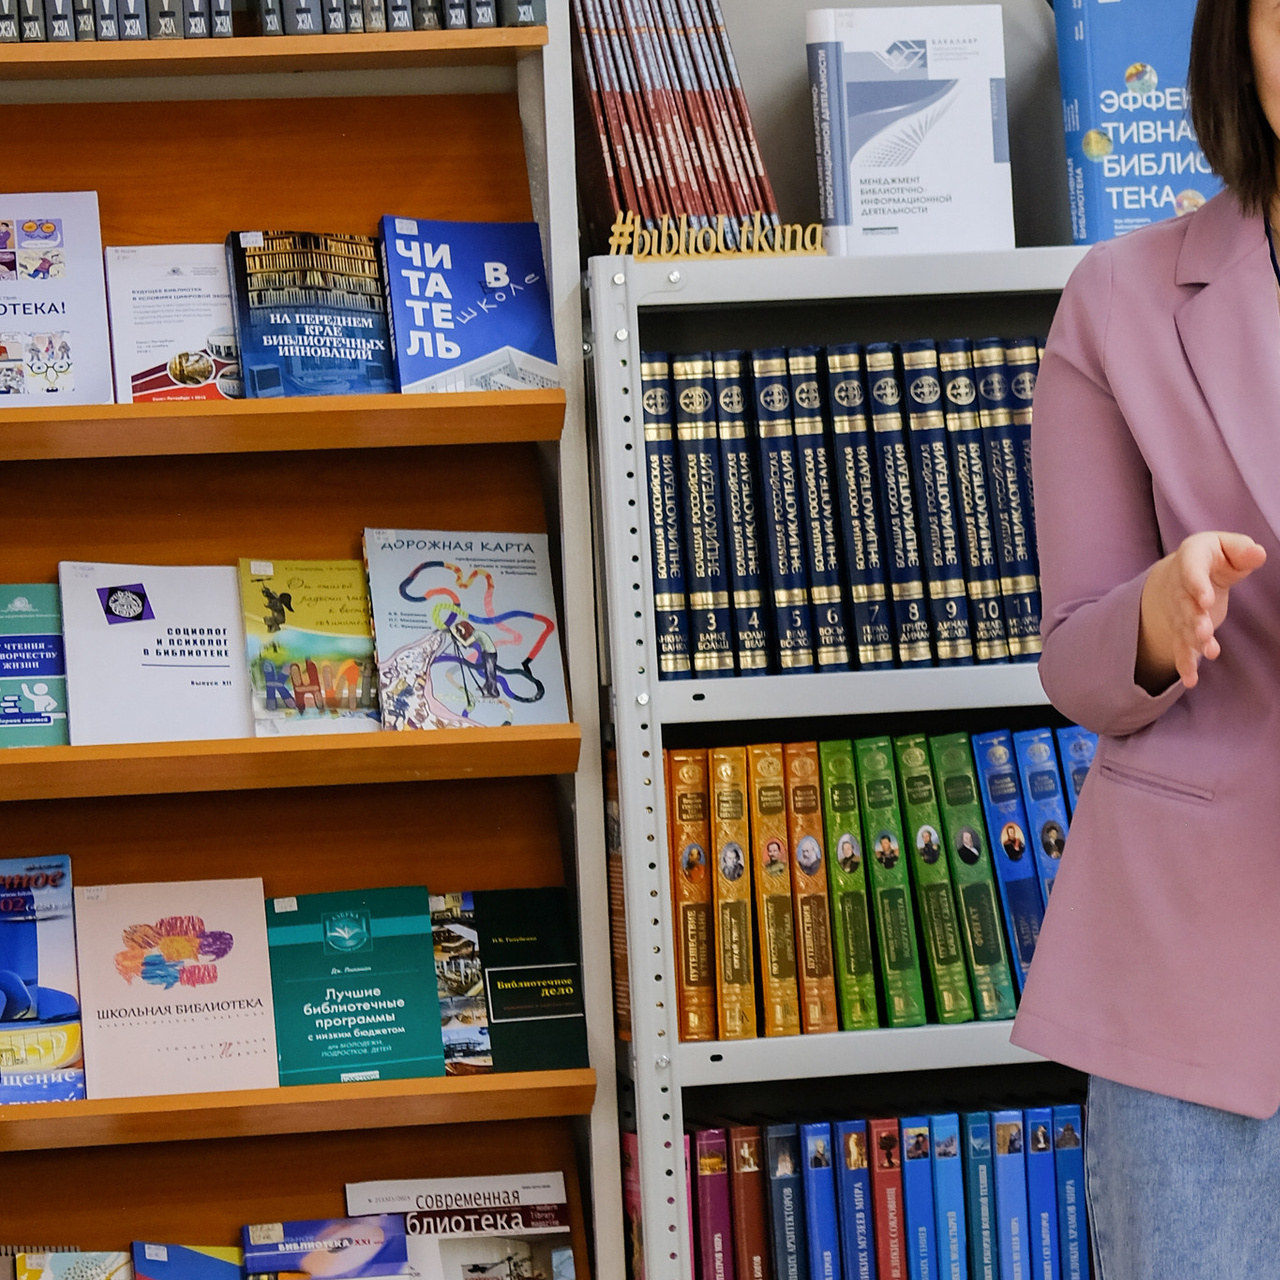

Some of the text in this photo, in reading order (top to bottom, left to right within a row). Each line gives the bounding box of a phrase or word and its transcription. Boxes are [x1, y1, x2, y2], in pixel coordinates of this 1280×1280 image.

[1101, 120, 1197, 144] ТИВНА
[860, 177, 920, 185] МЕНЕДЖМЕНТ
[861, 195, 953, 205] ИНФОРМАЦИОННОЙ
[1105, 185, 1177, 210] ТЕКА
[861, 207, 928, 216] ДЕЯТЕЛЬНОСТИ
[395, 239, 452, 270] ЧИ
[484, 261, 511, 288] В
[401, 269, 453, 300] ТА
[269, 313, 373, 329] НА ПЕРЕДНЕМ
[405, 299, 455, 329] ТЕ
[304, 324, 343, 337] КРАЕ
[262, 334, 386, 351] БИБЛИОТЕЧНЫХ
[406, 330, 462, 359] ЛЬ
[278, 346, 373, 361] ИННОВАЦИЙ
[650, 454, 667, 579] БОЛЬШАЯ РОССИЙСКАЯ
[663, 455, 681, 578] ЭНЦИКЛОПЕДИЯ
[380, 540, 534, 554] ДОРОЖНАЯ КАРТА
[827, 607, 838, 624] 6
[909, 603, 919, 620] 8
[946, 601, 957, 618] 9
[979, 600, 999, 619] 10
[668, 615, 679, 632] 2
[707, 612, 717, 630] 3
[748, 611, 759, 629] 4
[792, 610, 801, 627] 5
[167, 627, 228, 636] СОЦИОЛОГ
[169, 639, 228, 647] ПСИХОЛОГ
[0, 651, 57, 660] ВОРЧЕСТВУ
[155, 649, 230, 657] БИБЛИОТЕКЕ
[2, 661, 39, 670] ЖИЗНИ
[687, 910, 699, 981] ПУТЕШЕСТВИЕ
[497, 977, 573, 991] Библиотечное
[541, 986, 574, 997] дело
[325, 987, 381, 1001] Лучшие
[97, 998, 263, 1020] ШКОЛЬНАЯ БИБЛИОТЕКА
[303, 998, 405, 1016] библиотечные
[315, 1012, 396, 1029] программы
[316, 1031, 351, 1041] низким
[354, 1026, 405, 1038] бюджетом
[415, 1190, 521, 1211] современная
[853, 1182, 866, 1210] МИРА
[405, 1211, 524, 1235] блиотека
[855, 1212, 869, 1248] МУЗЕЕВ
[278, 1239, 350, 1252] БИБЛИОТЕКА
